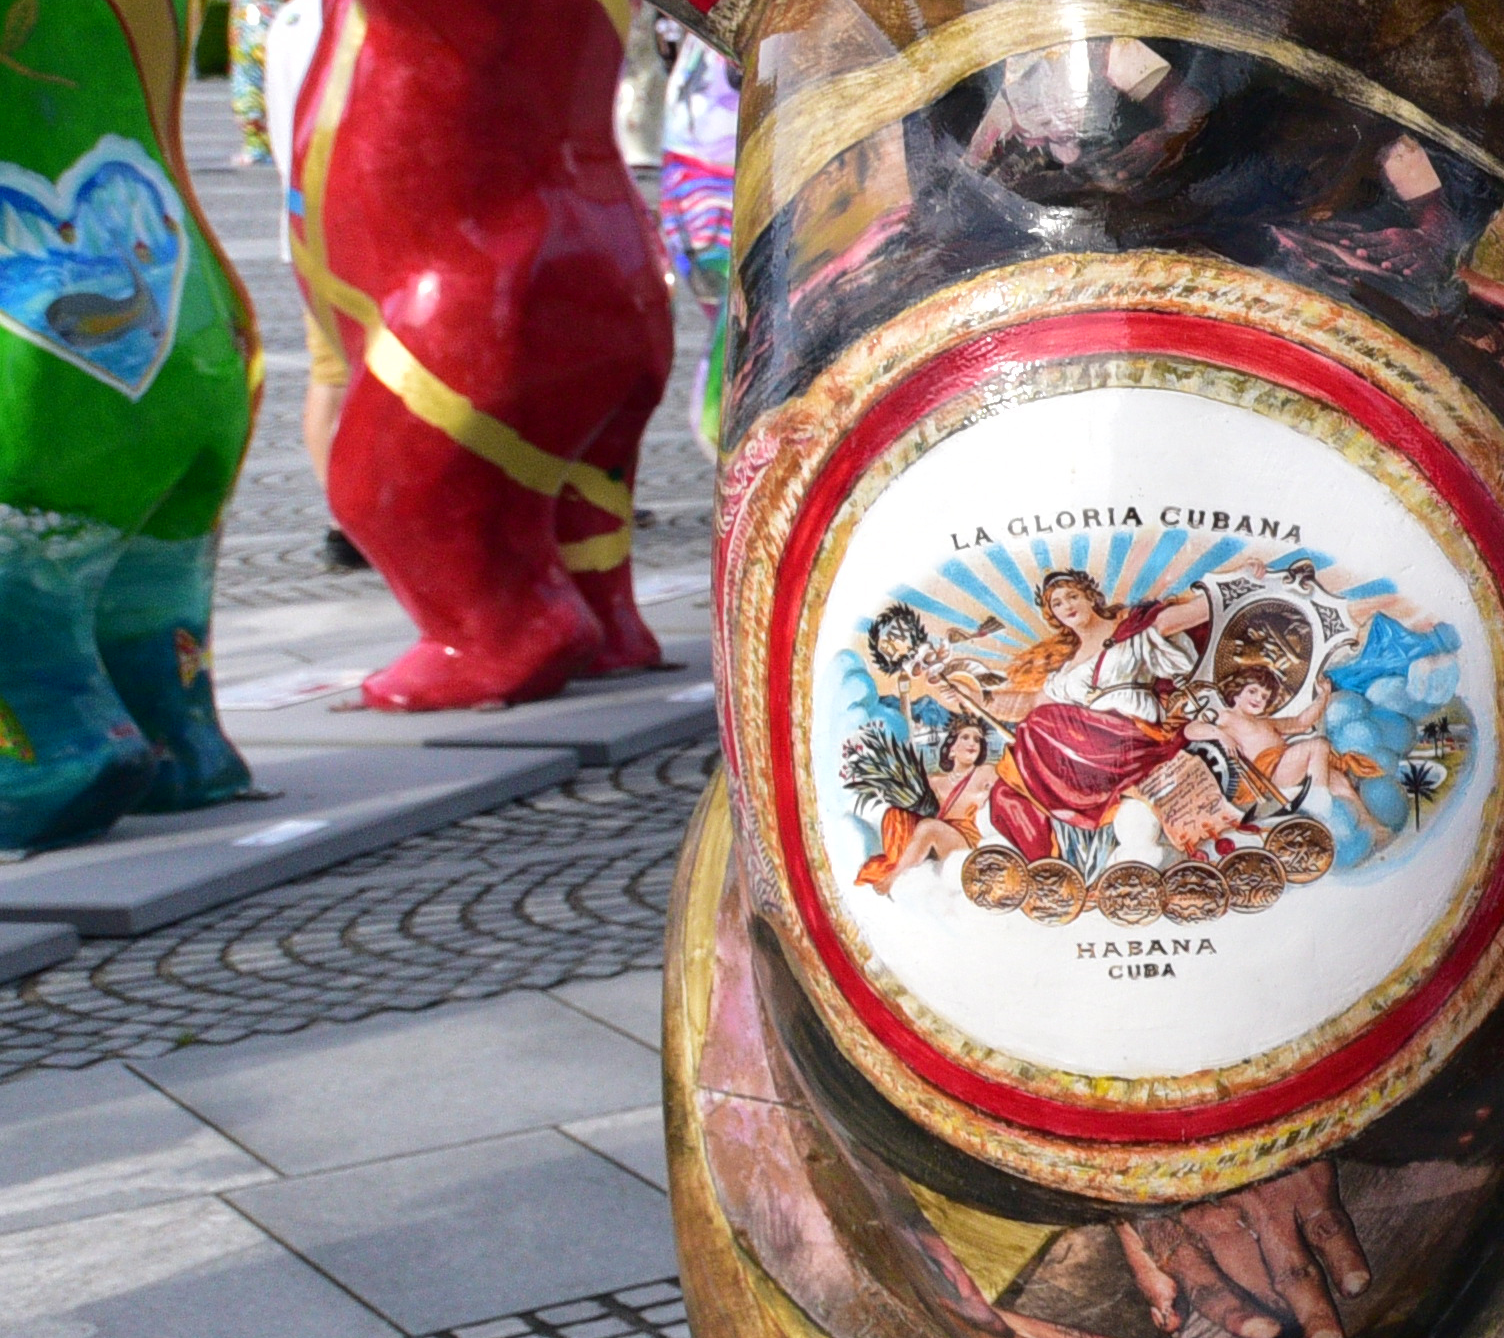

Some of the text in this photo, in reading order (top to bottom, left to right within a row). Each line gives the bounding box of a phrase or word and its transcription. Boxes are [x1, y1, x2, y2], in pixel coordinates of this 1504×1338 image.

[950, 506, 1303, 551] LA GLORIA CUBANA
[1076, 938, 1217, 959] HABANA
[1108, 963, 1176, 980] CUBA
